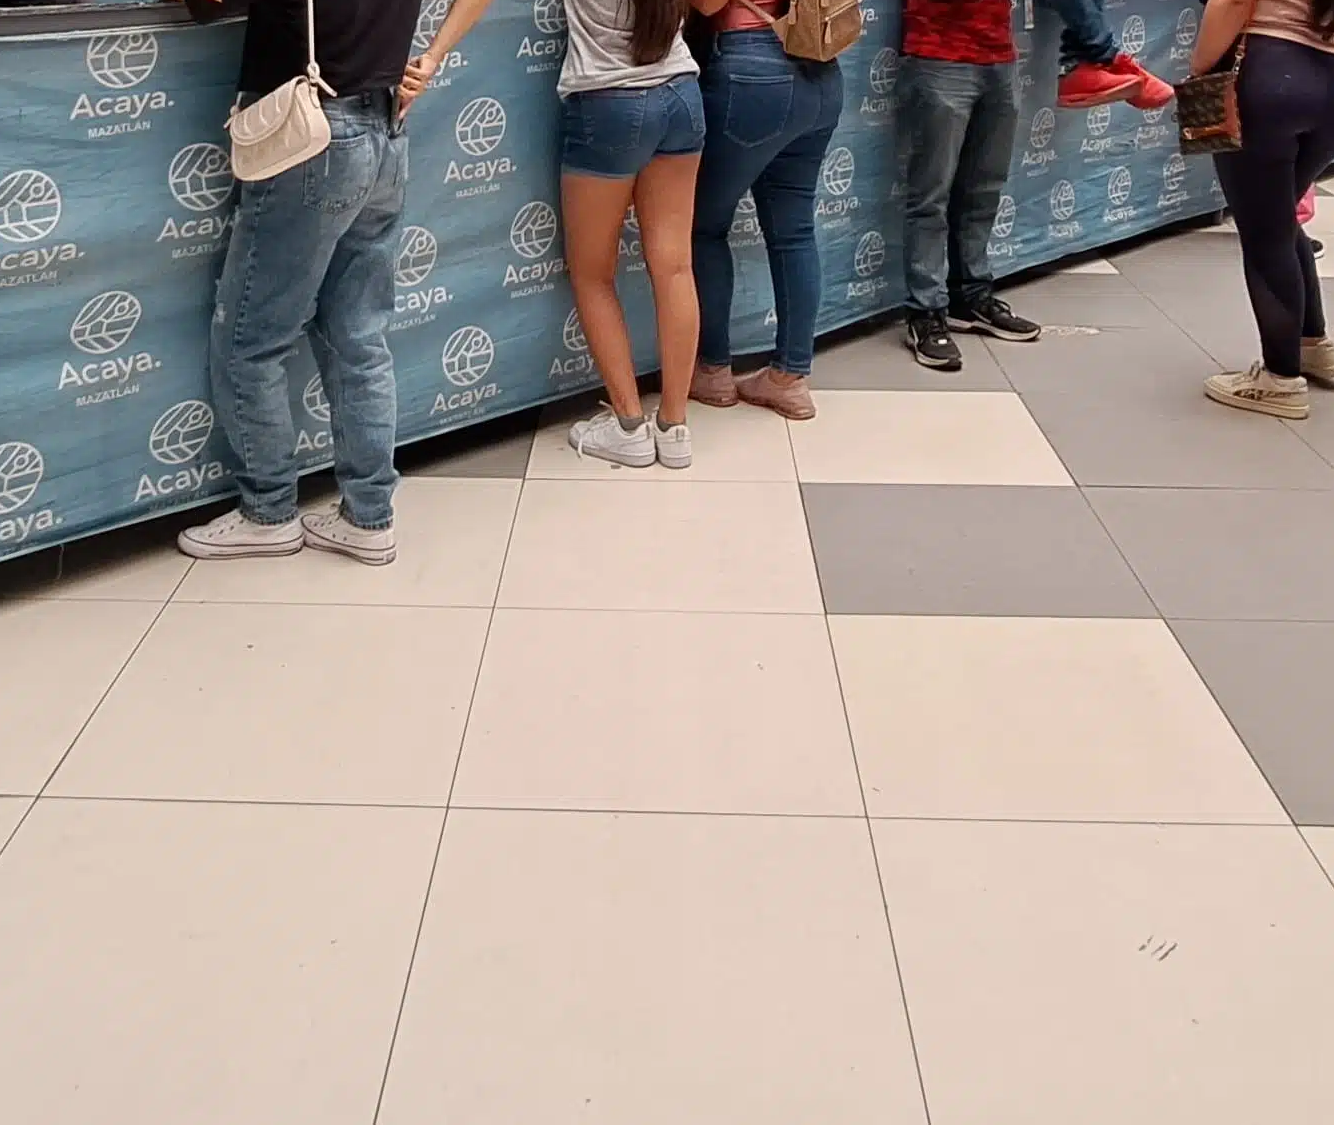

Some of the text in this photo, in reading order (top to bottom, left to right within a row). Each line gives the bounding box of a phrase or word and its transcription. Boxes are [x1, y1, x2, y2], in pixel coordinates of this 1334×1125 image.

[70, 88, 175, 122] Acaya.
[444, 156, 518, 184] Acaya.
[816, 196, 862, 216] Acaya.
[393, 283, 454, 314] caya.
[845, 276, 888, 299] Acaya.
[59, 349, 162, 391] Acaya.
[430, 381, 503, 414] Acaya.
[133, 459, 232, 504] Acaya.
